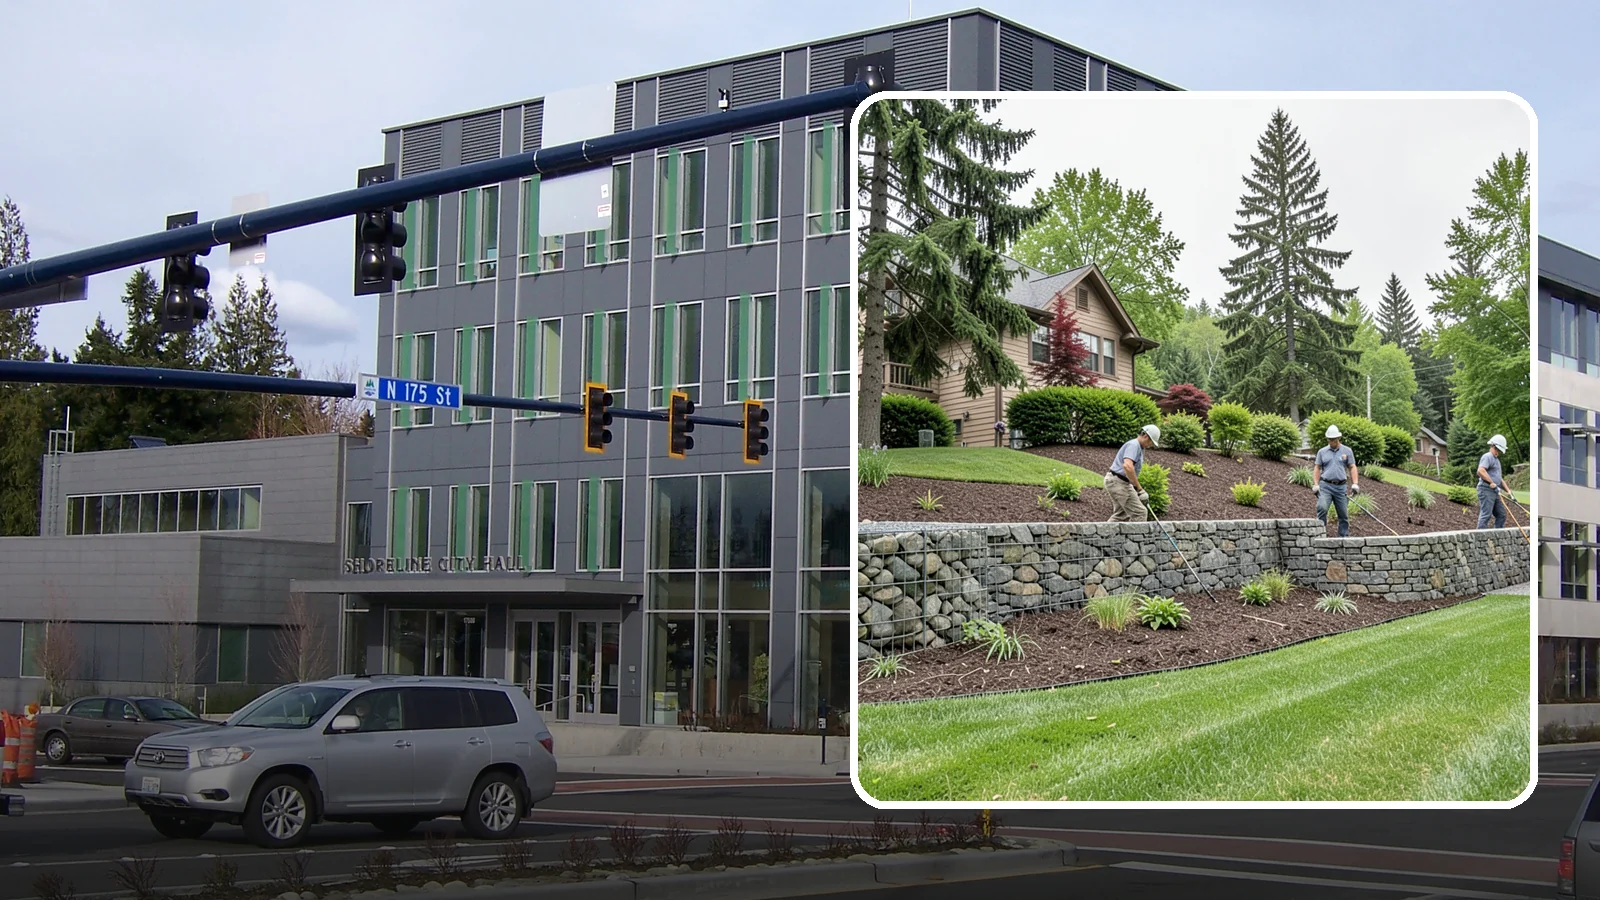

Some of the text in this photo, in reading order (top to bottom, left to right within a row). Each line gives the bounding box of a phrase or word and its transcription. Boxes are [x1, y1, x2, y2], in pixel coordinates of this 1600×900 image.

[387, 380, 451, 406] N 175 St
[344, 555, 525, 574] SHORELINE CITY HALL
